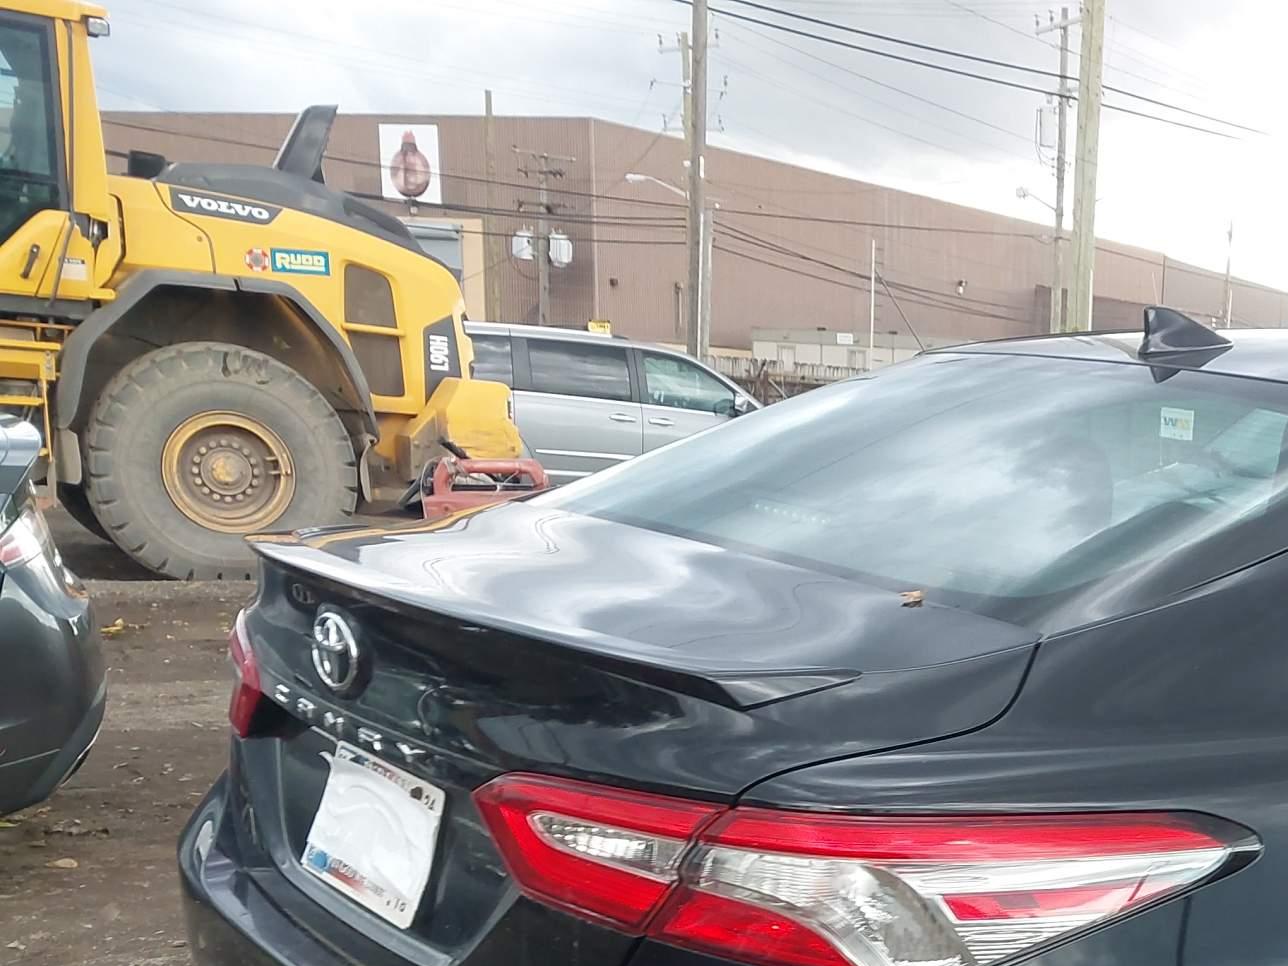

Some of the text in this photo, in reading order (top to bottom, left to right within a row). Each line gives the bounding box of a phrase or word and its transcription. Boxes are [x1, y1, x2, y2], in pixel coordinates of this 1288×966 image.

[178, 194, 270, 220] VOLVO
[275, 252, 326, 270] RUDD
[429, 334, 449, 371] L90H
[275, 684, 426, 763] CAMRY
